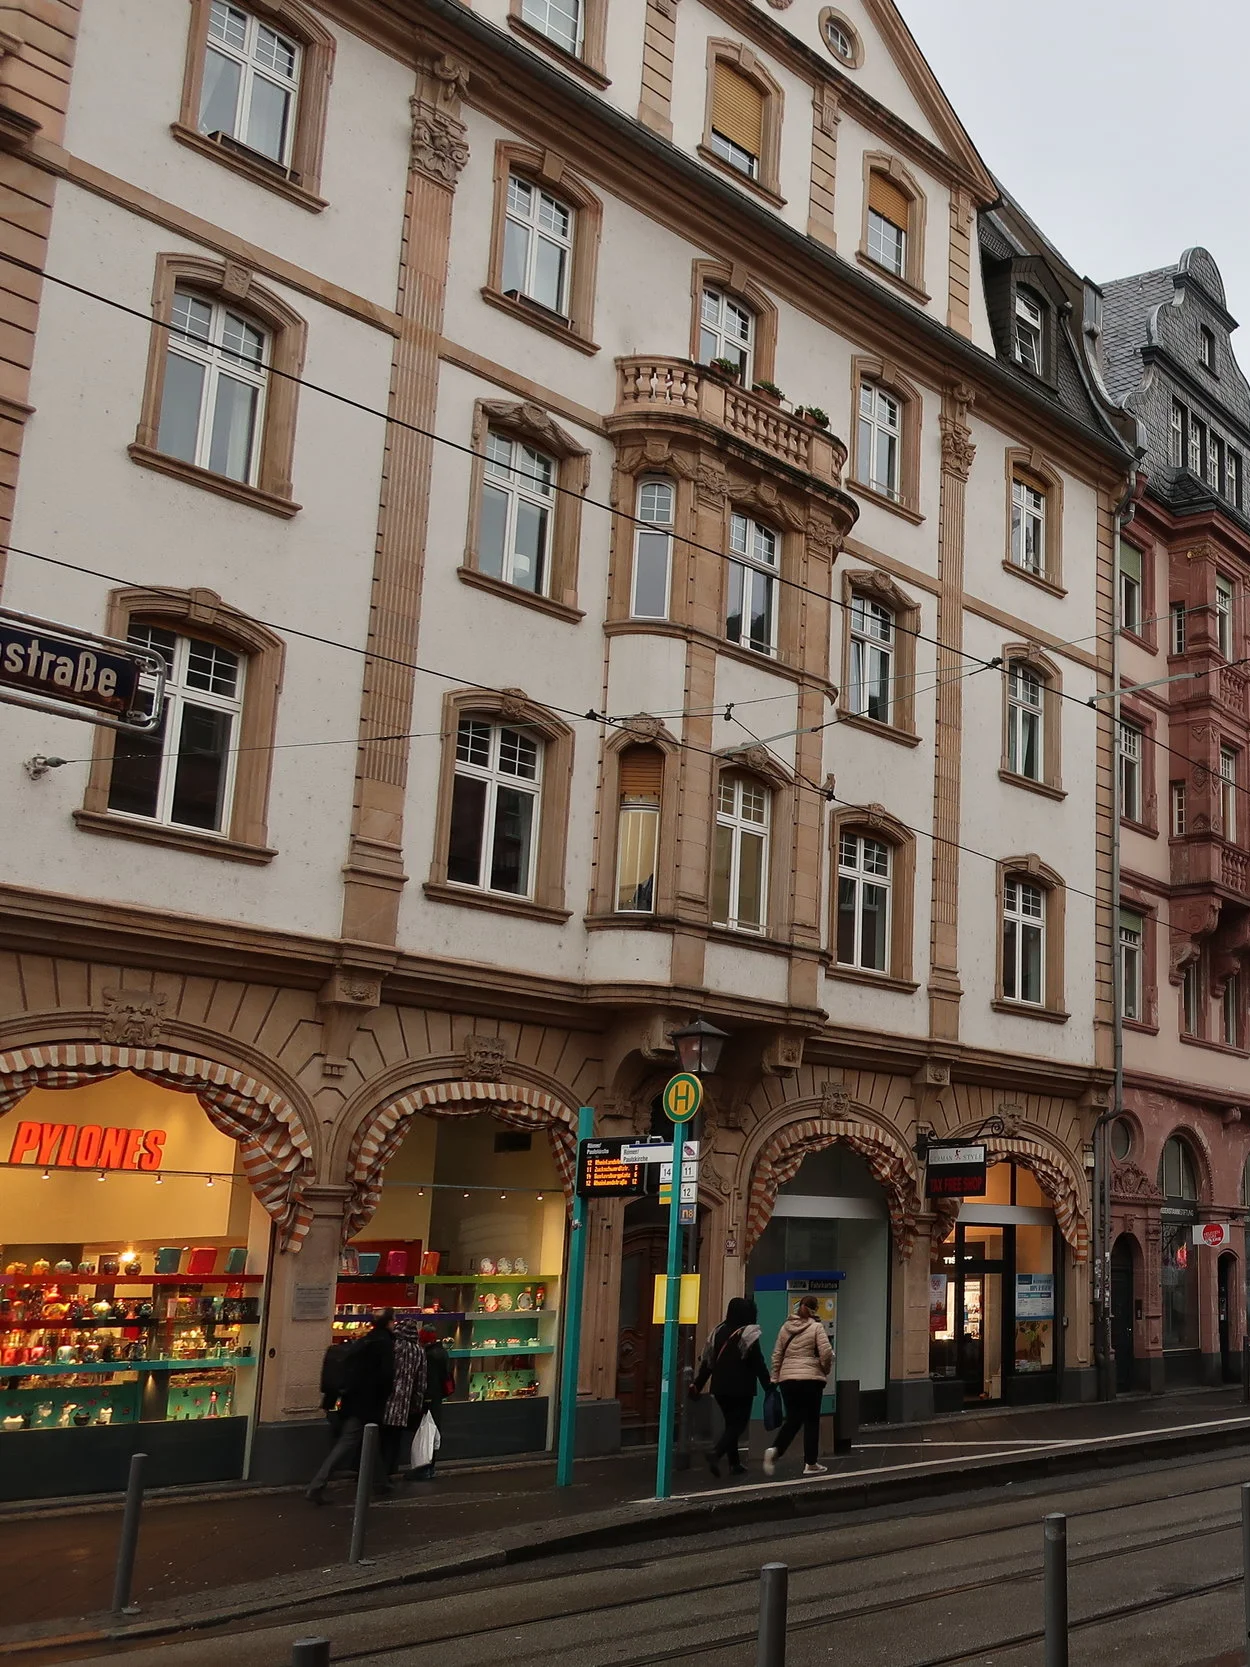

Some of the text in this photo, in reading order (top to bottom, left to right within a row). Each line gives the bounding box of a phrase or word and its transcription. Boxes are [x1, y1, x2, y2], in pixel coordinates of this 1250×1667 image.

[0, 639, 118, 698] straße
[673, 1084, 690, 1111] H
[8, 1121, 167, 1171] PYLONES
[663, 1168, 671, 1177] 14
[684, 1167, 692, 1175] 11
[930, 1176, 983, 1192] TAX FREE SHOP
[683, 1188, 691, 1197] 12
